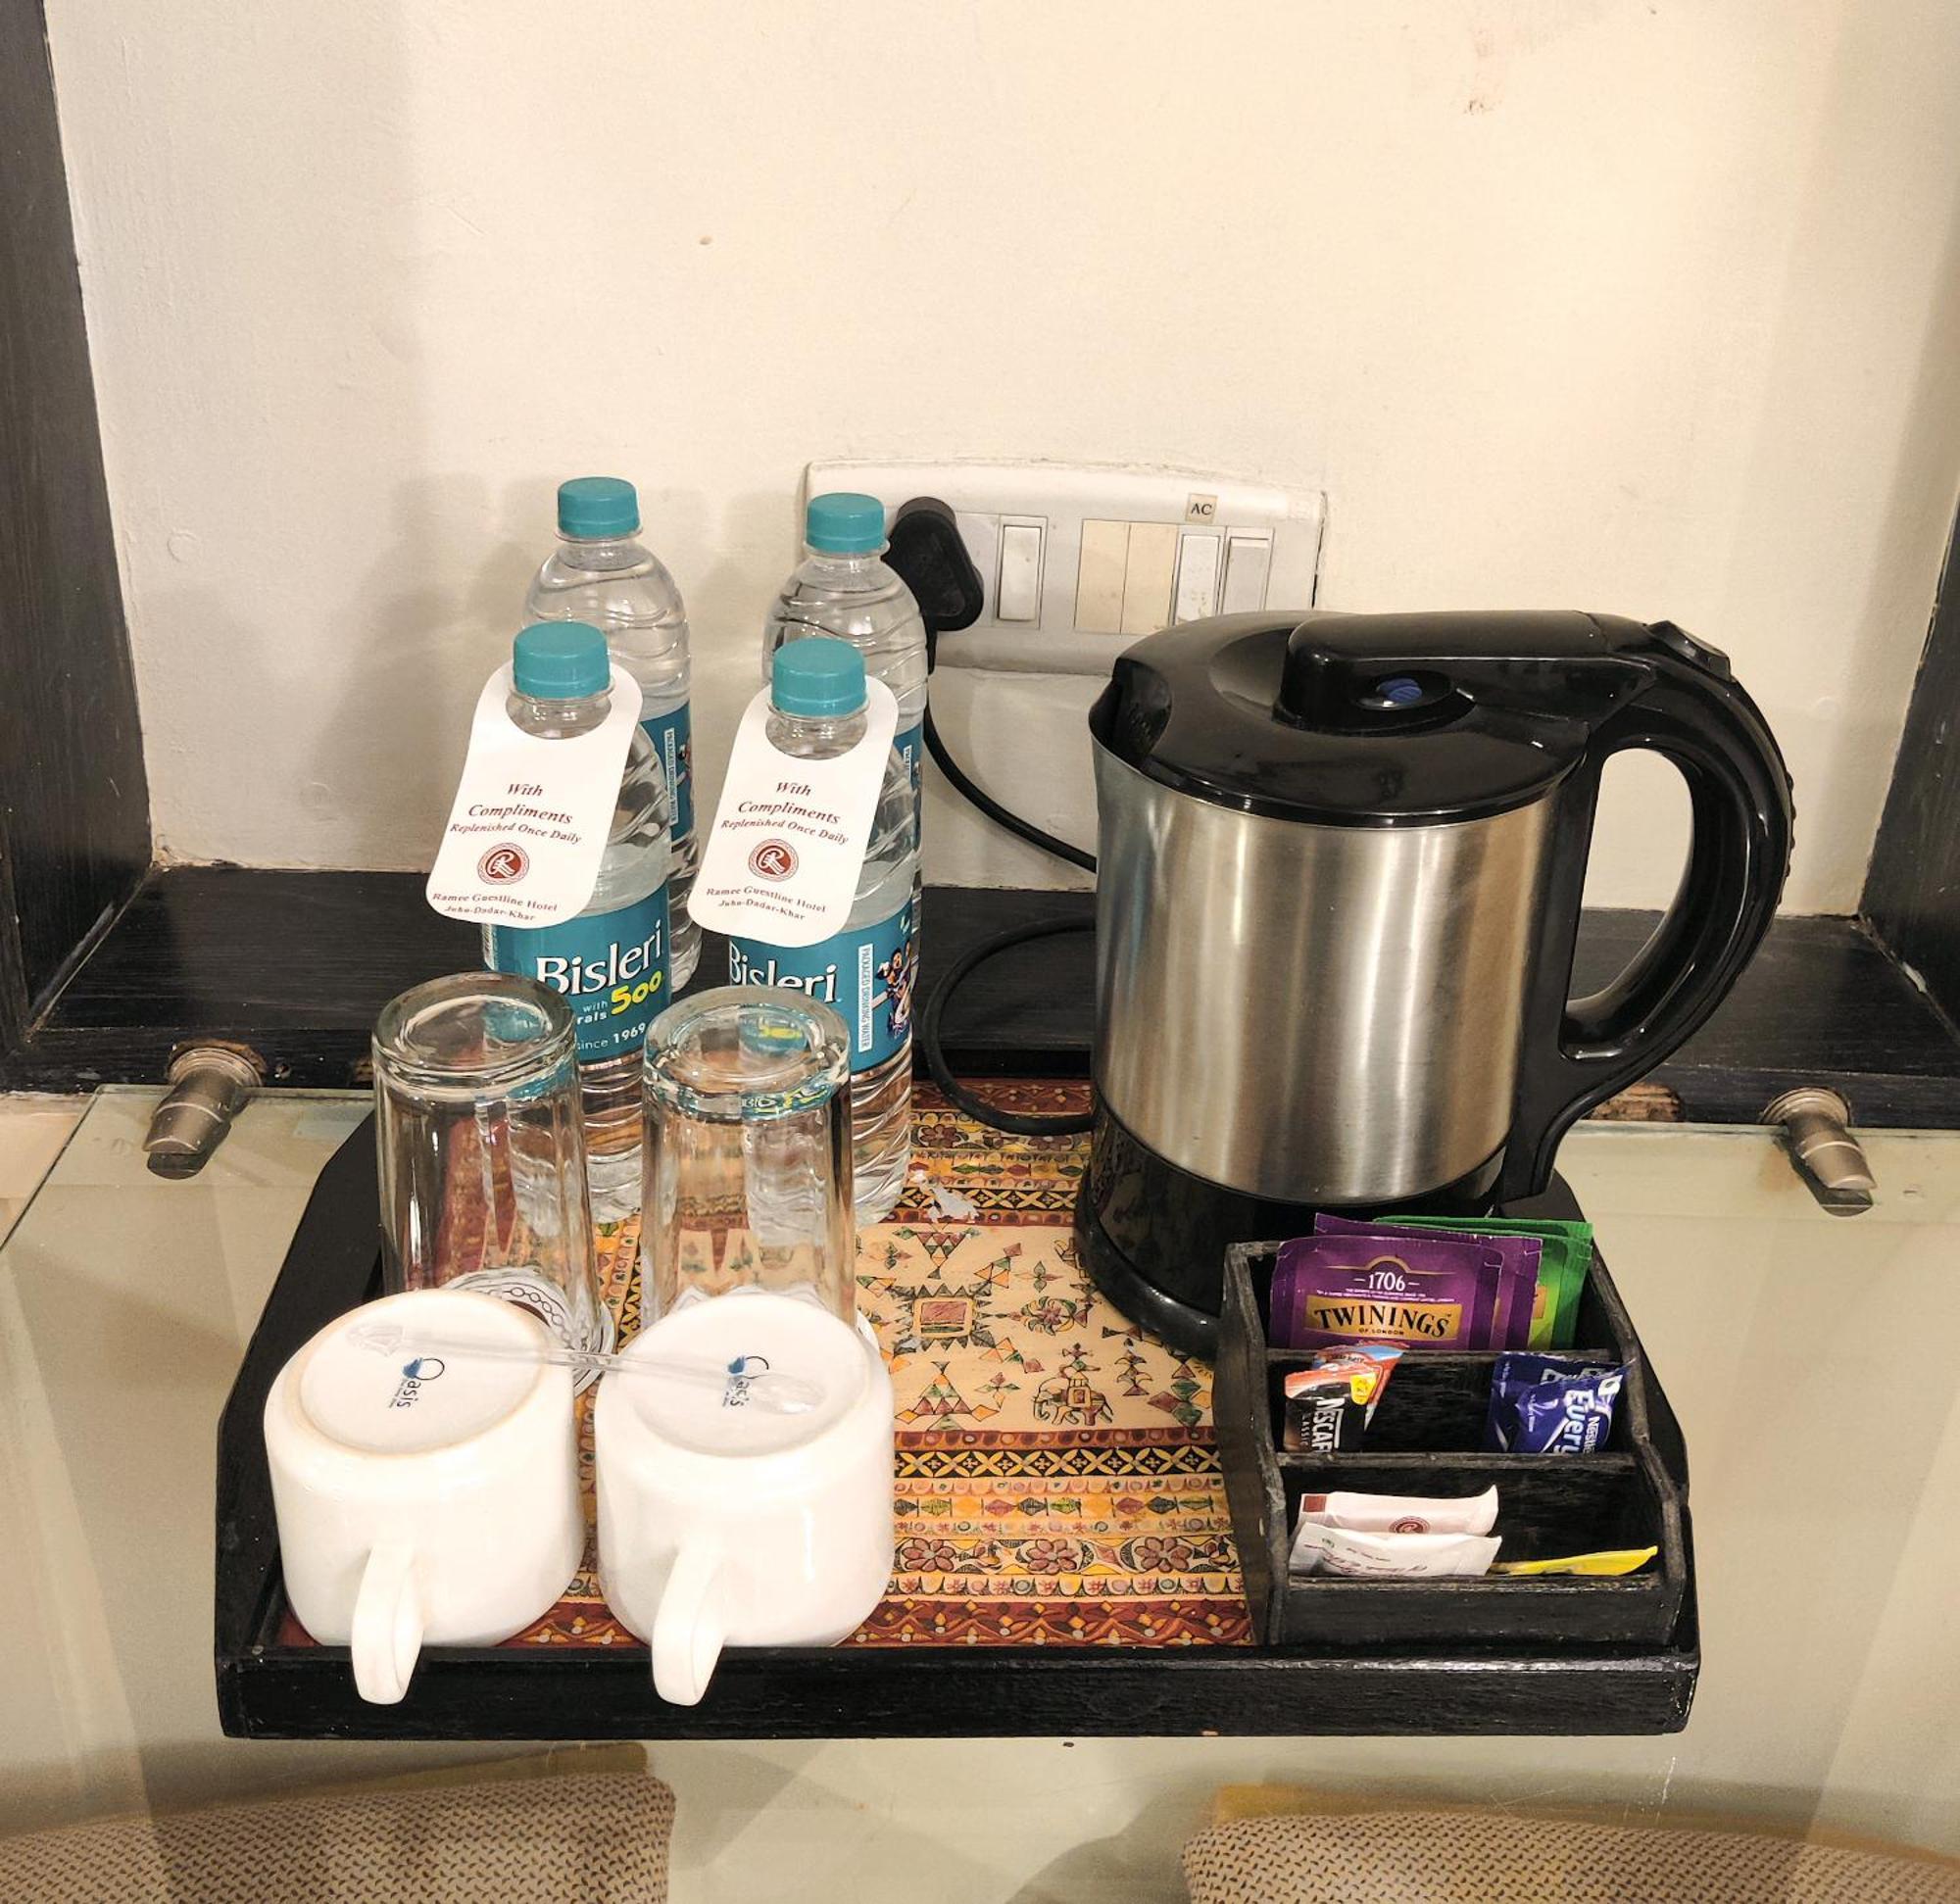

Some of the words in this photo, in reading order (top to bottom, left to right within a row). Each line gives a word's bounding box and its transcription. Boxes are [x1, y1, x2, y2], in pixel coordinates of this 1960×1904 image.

[1191, 503, 1212, 515] AC
[507, 783, 544, 797] With
[775, 782, 811, 797] With
[468, 804, 573, 824] Compliments
[738, 801, 842, 825] Compliments
[450, 823, 516, 834] Replenished
[518, 823, 549, 838] Once
[550, 831, 582, 845] Daily
[720, 818, 785, 830] Replenished
[787, 821, 817, 837] Once
[818, 829, 850, 846] Daily
[526, 900, 559, 912] Hotel
[797, 898, 827, 913] Hotel
[536, 919, 662, 996] Bisleri
[729, 940, 838, 1003] Bisleri
[611, 970, 662, 1015] 500
[582, 999, 609, 1013] with
[576, 1010, 608, 1025] rals
[612, 1022, 646, 1045] 1969
[1314, 1304, 1450, 1338] TWININGS
[1552, 1390, 1594, 1454] Every
